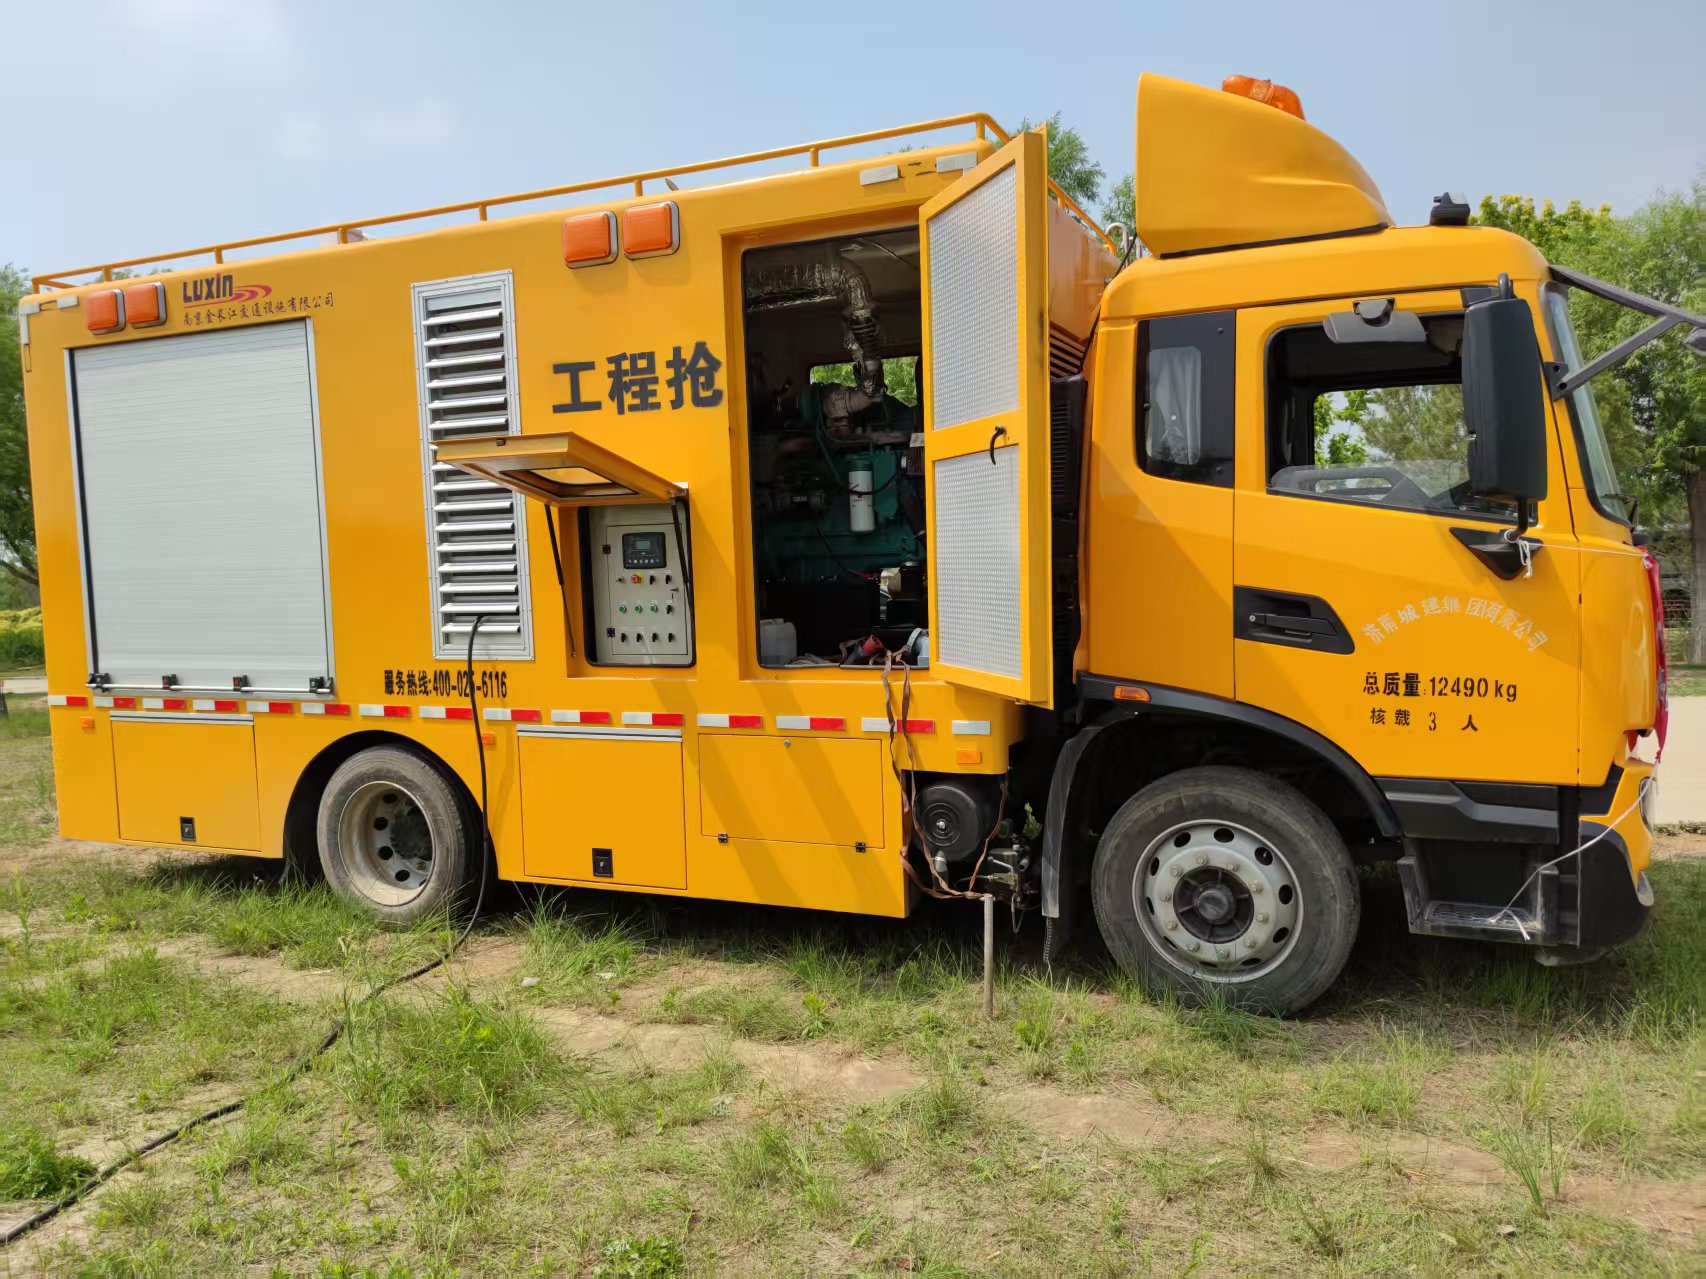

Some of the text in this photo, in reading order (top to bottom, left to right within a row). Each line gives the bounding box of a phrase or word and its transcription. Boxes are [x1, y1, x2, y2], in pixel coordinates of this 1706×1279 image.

[552, 341, 723, 415] 工程抢
[1495, 680, 1517, 702] kg
[1428, 711, 1437, 731] 3
[1461, 714, 1478, 732] 人
